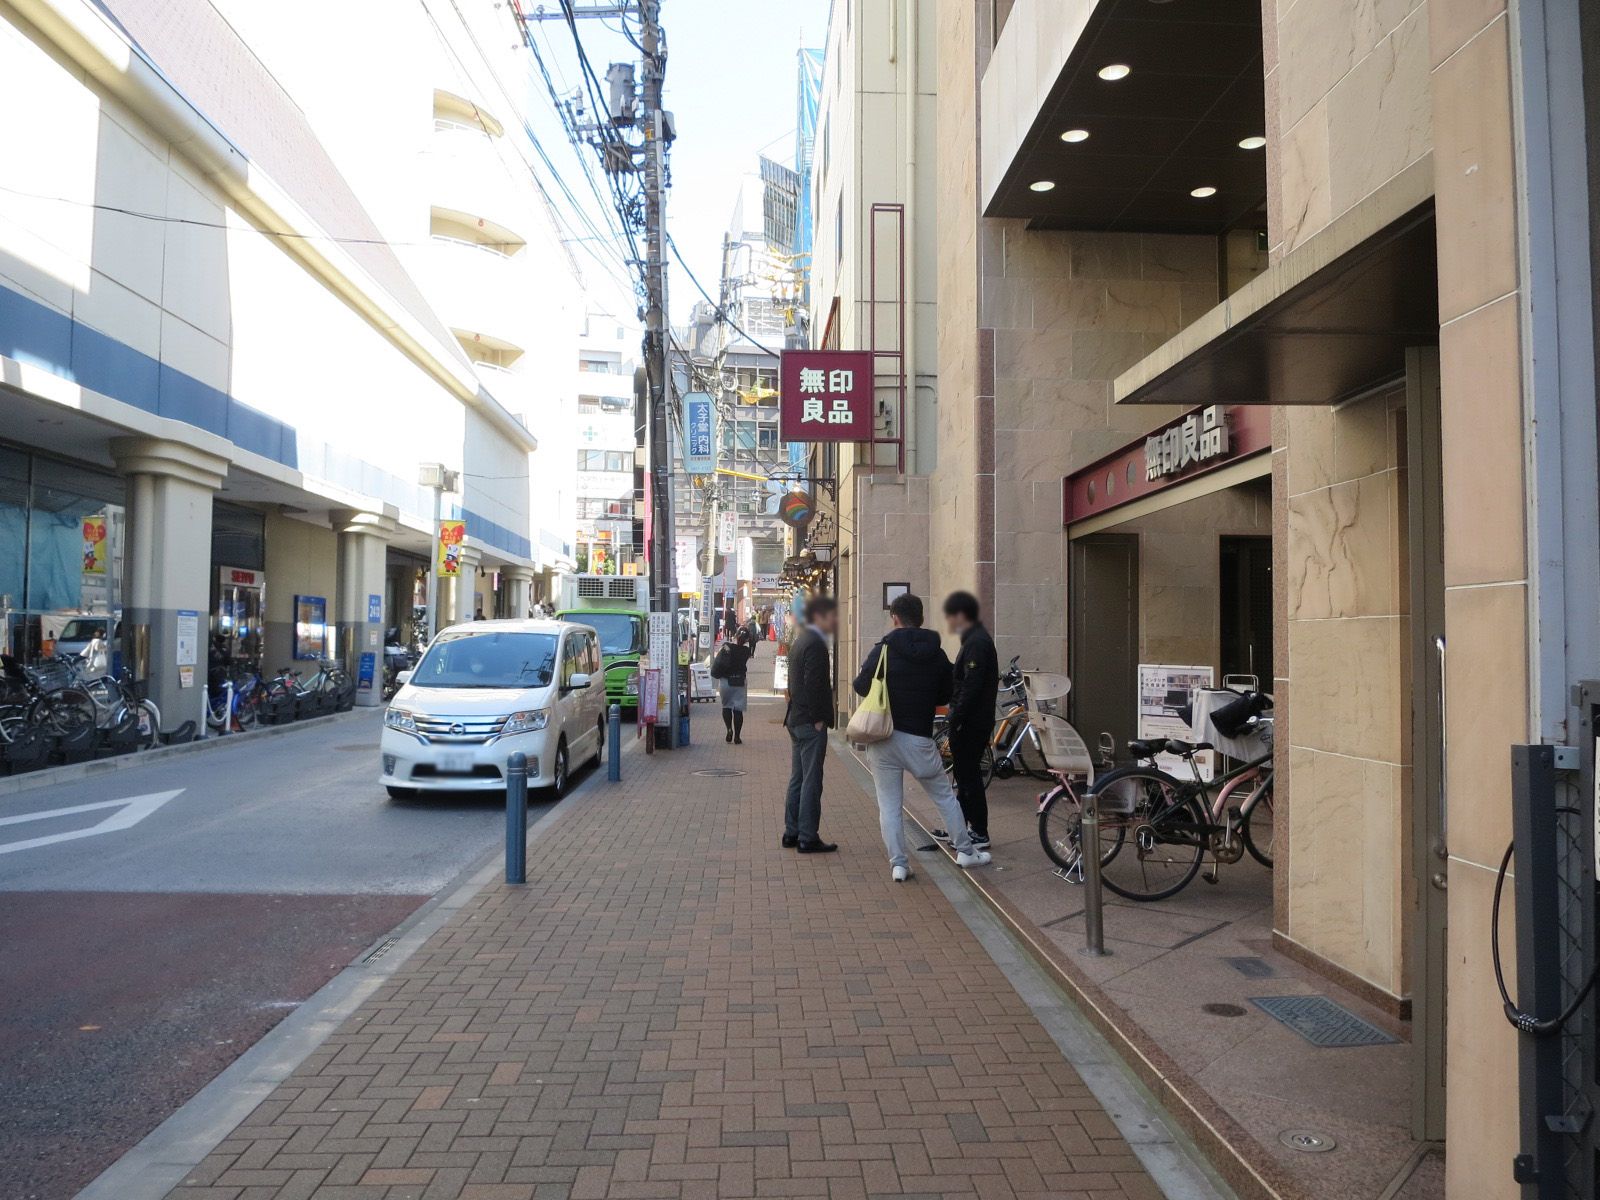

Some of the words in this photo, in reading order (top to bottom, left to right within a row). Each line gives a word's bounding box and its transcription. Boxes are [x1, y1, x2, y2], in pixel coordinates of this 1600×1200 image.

[799, 367, 853, 394] 無印
[800, 397, 853, 424] 良品
[690, 422, 698, 455] クリニック
[1144, 404, 1227, 482] 無印良品
[231, 570, 255, 585] SEIYU
